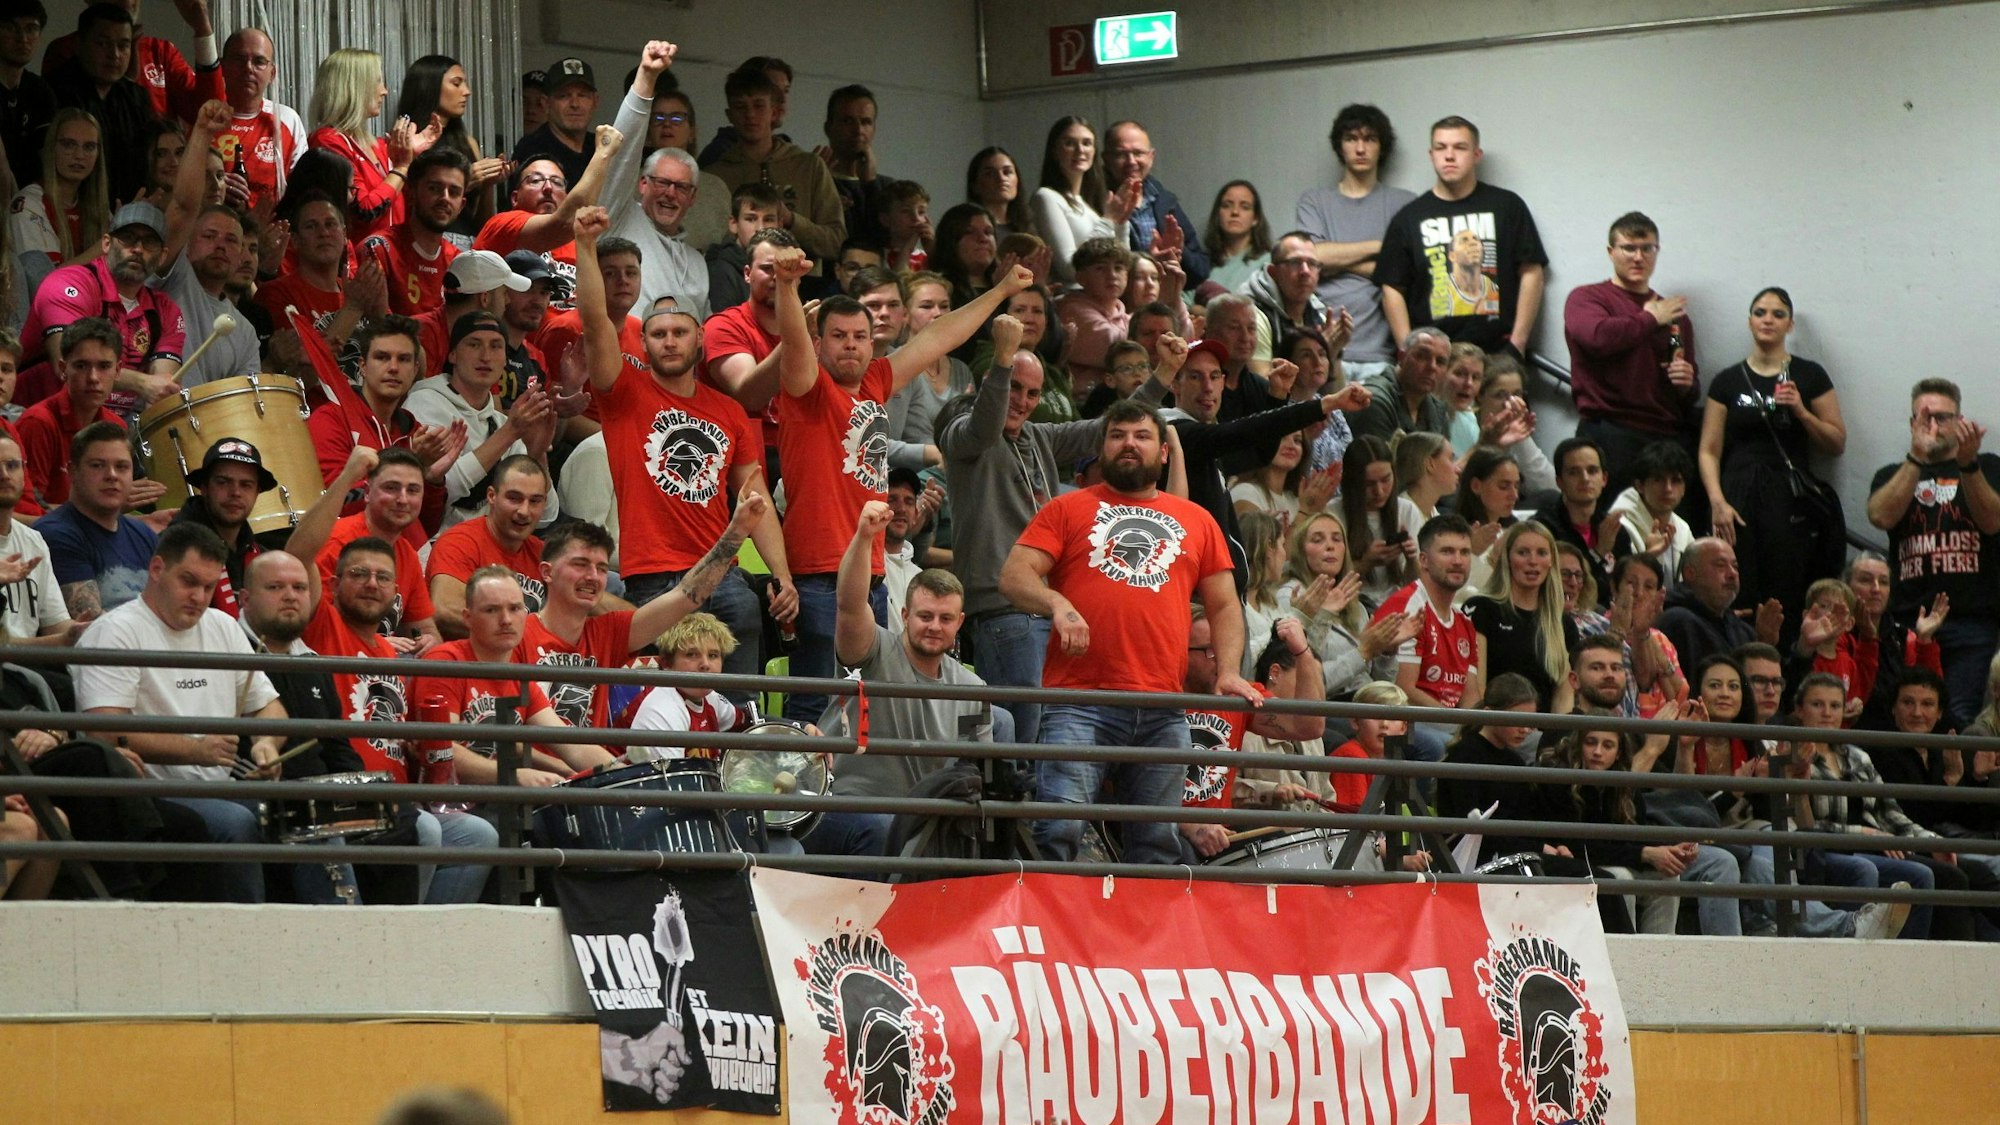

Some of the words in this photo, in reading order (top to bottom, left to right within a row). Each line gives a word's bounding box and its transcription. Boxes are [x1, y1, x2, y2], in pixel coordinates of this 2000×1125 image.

[216, 134, 239, 161] 8
[1420, 211, 1497, 247] SLAM
[407, 273, 421, 304] 5
[655, 473, 681, 496] TVP
[855, 469, 875, 488] TVP
[1100, 560, 1127, 581] TVP
[176, 678, 208, 689] adidas
[571, 933, 661, 990] PYRO
[807, 934, 907, 1035] RÄUBERBANDE
[1491, 937, 1581, 1038] RÄUBERBANDE
[950, 926, 1472, 1125] RÄUBERBANDE
